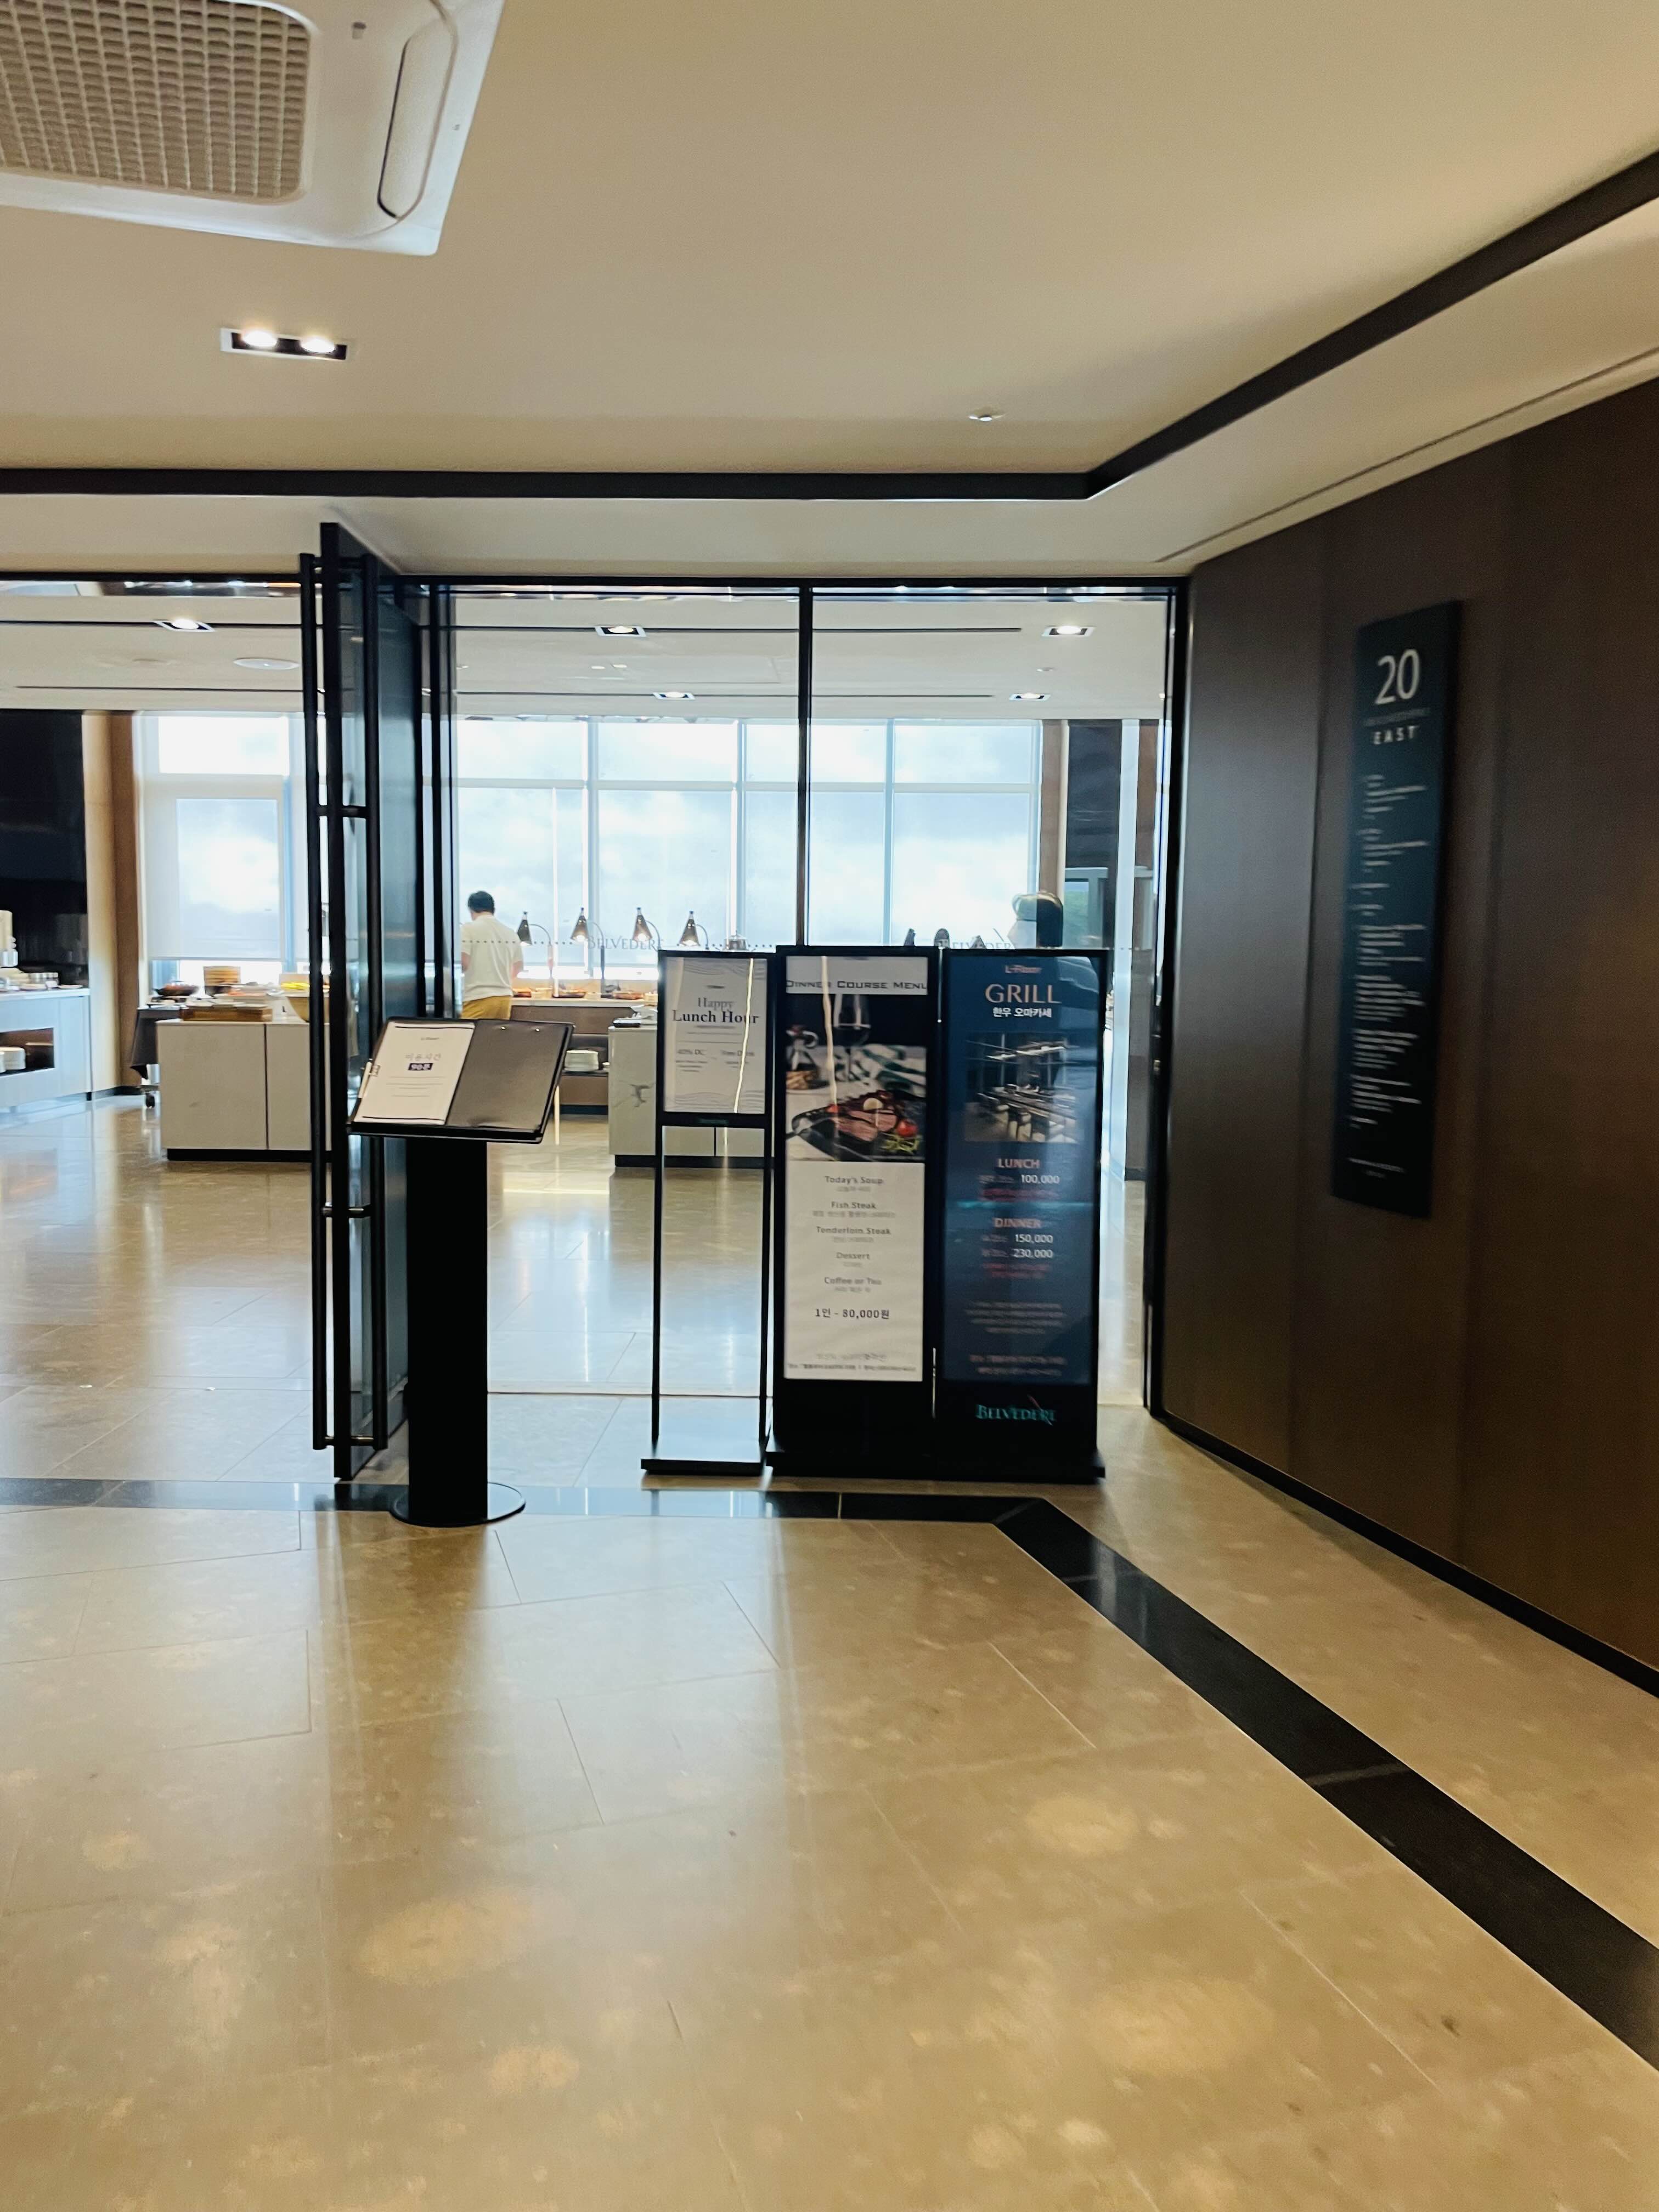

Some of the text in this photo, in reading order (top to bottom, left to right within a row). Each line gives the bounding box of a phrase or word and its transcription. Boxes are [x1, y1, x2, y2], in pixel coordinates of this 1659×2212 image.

[1375, 649, 1420, 704] 20
[1373, 725, 1419, 745] EAST
[985, 984, 1062, 1003] GRILL
[697, 997, 733, 1013] Happy
[672, 1009, 716, 1022] Lunch
[997, 1159, 1040, 1169] LUNCH
[825, 1176, 883, 1186] Today's Soup
[1021, 1175, 1060, 1184] 100,000
[994, 1218, 1042, 1228] DINNER
[1015, 1234, 1053, 1244] 150,000
[1013, 1249, 1053, 1258] 230,000
[815, 1308, 831, 1318] 1인
